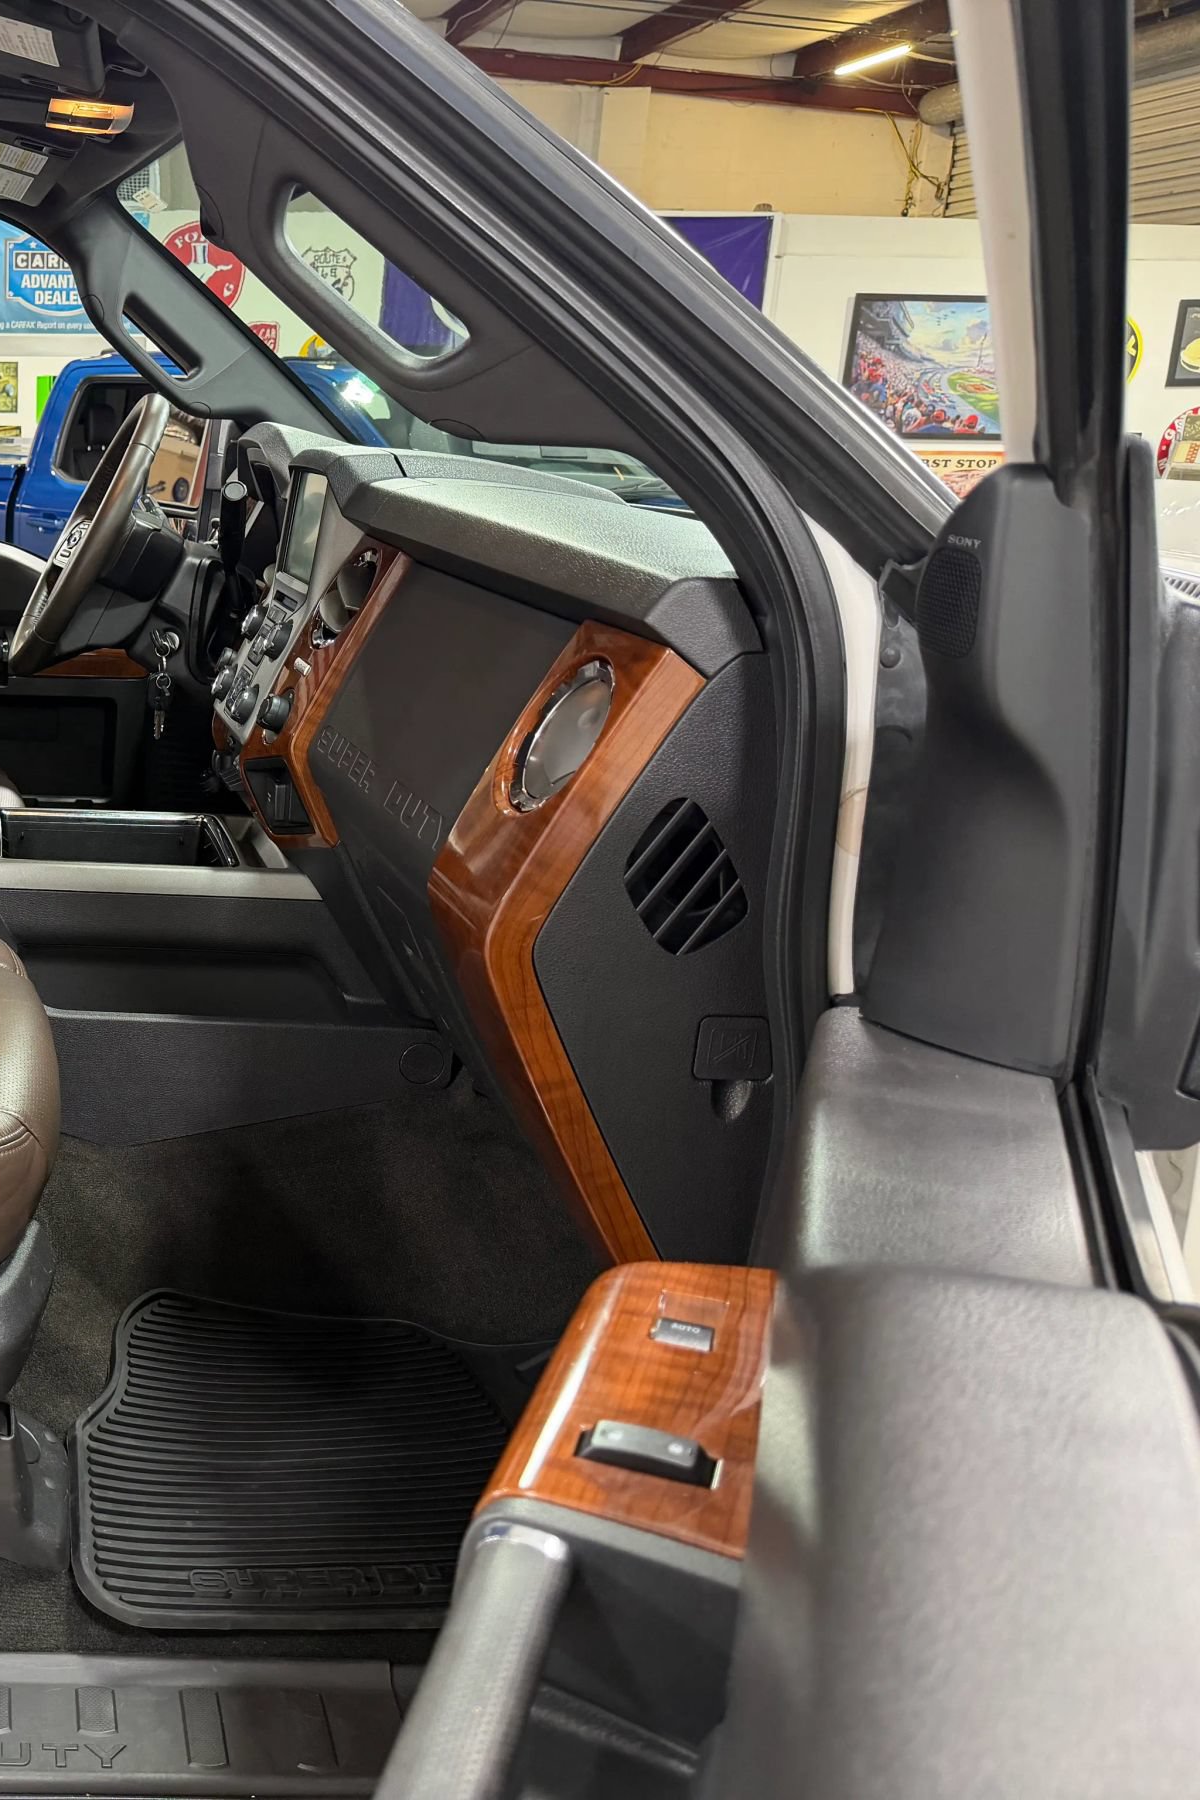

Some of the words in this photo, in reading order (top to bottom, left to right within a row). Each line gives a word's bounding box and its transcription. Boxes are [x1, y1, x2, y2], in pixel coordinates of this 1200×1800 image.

[21, 273, 76, 288] ADVANT
[35, 290, 82, 305] DEALE
[955, 459, 997, 469] STOP
[947, 534, 981, 549] SONY
[383, 779, 443, 852] DUTY
[671, 1322, 701, 1334] AUTO
[189, 1567, 364, 1598] SUPER
